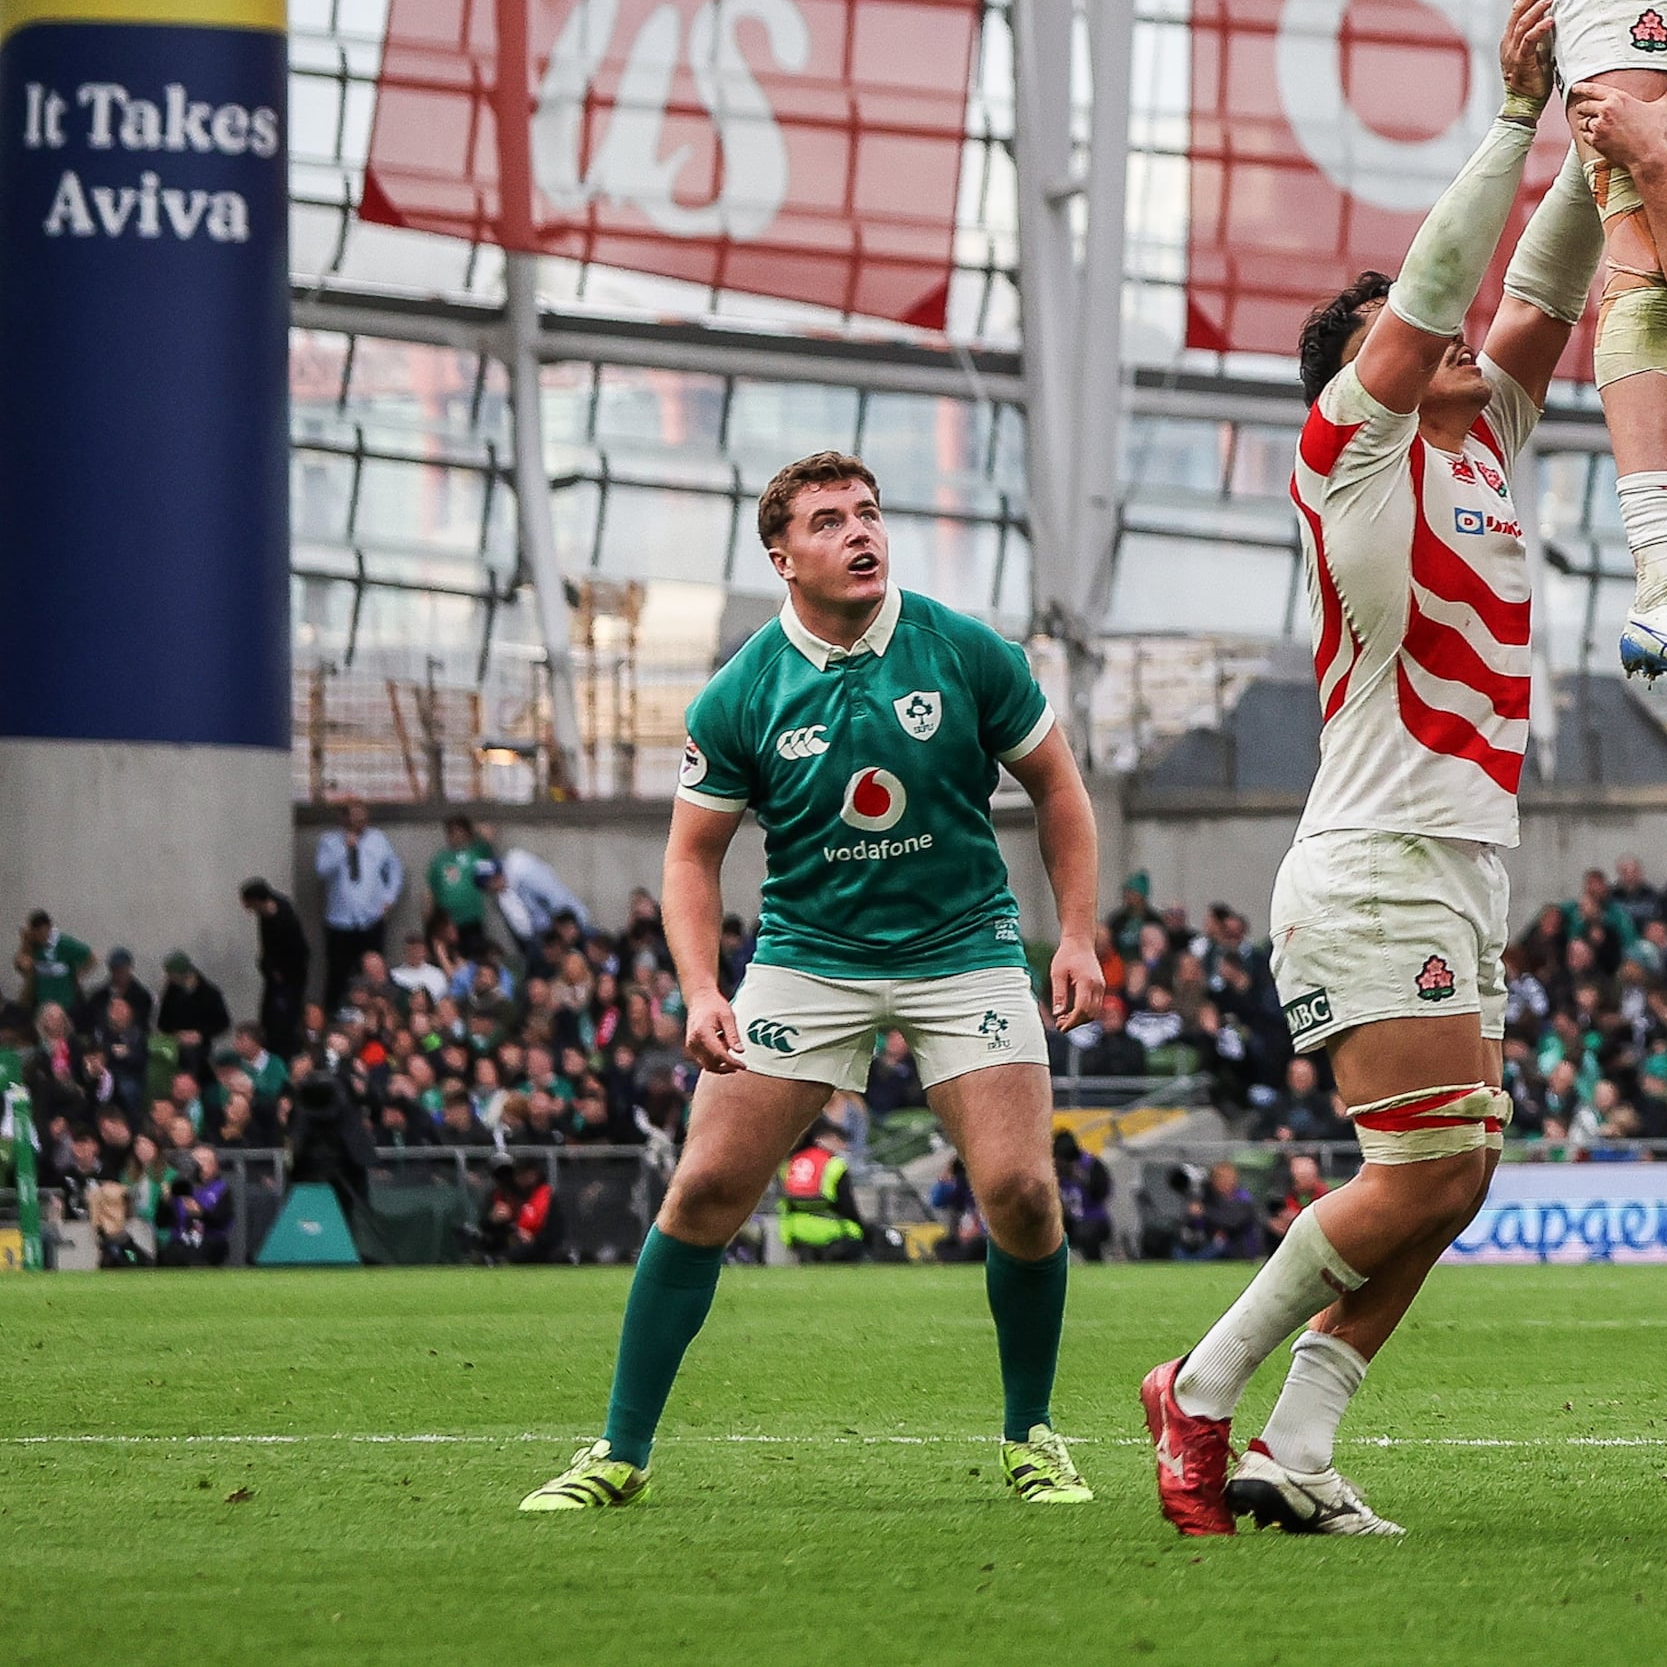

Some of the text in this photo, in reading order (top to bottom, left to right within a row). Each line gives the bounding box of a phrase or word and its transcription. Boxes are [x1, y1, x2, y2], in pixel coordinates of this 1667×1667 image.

[24, 81, 280, 159] It Takes
[43, 169, 250, 244] Aviva
[823, 833, 934, 863] vodafone
[1285, 995, 1331, 1035] MBC
